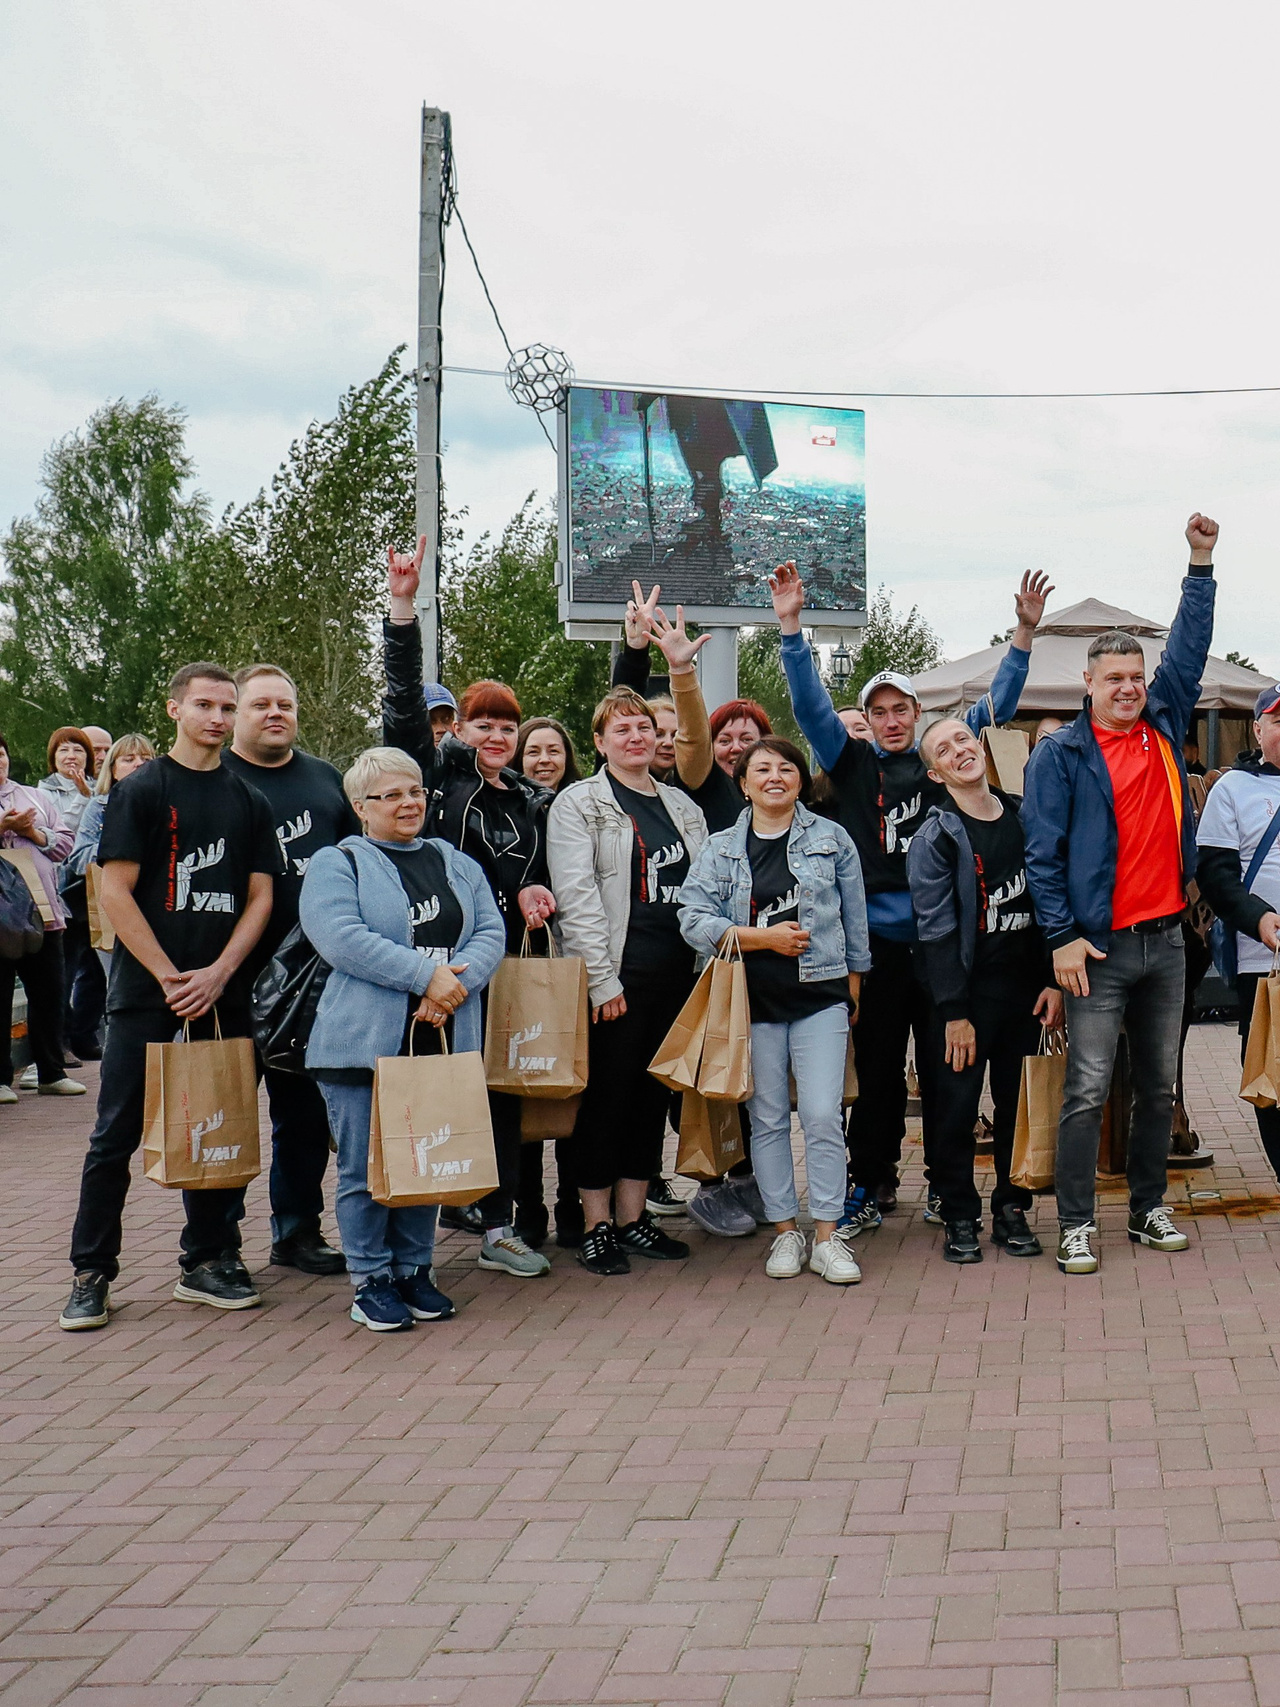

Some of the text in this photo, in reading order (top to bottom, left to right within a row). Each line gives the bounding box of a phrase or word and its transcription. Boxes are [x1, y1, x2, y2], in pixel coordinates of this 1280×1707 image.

[191, 891, 235, 914] УМ
[1000, 912, 1031, 932] УМ
[518, 1056, 558, 1071] УМТ
[201, 1144, 242, 1163] УМТ
[430, 1158, 473, 1177] УМТ
